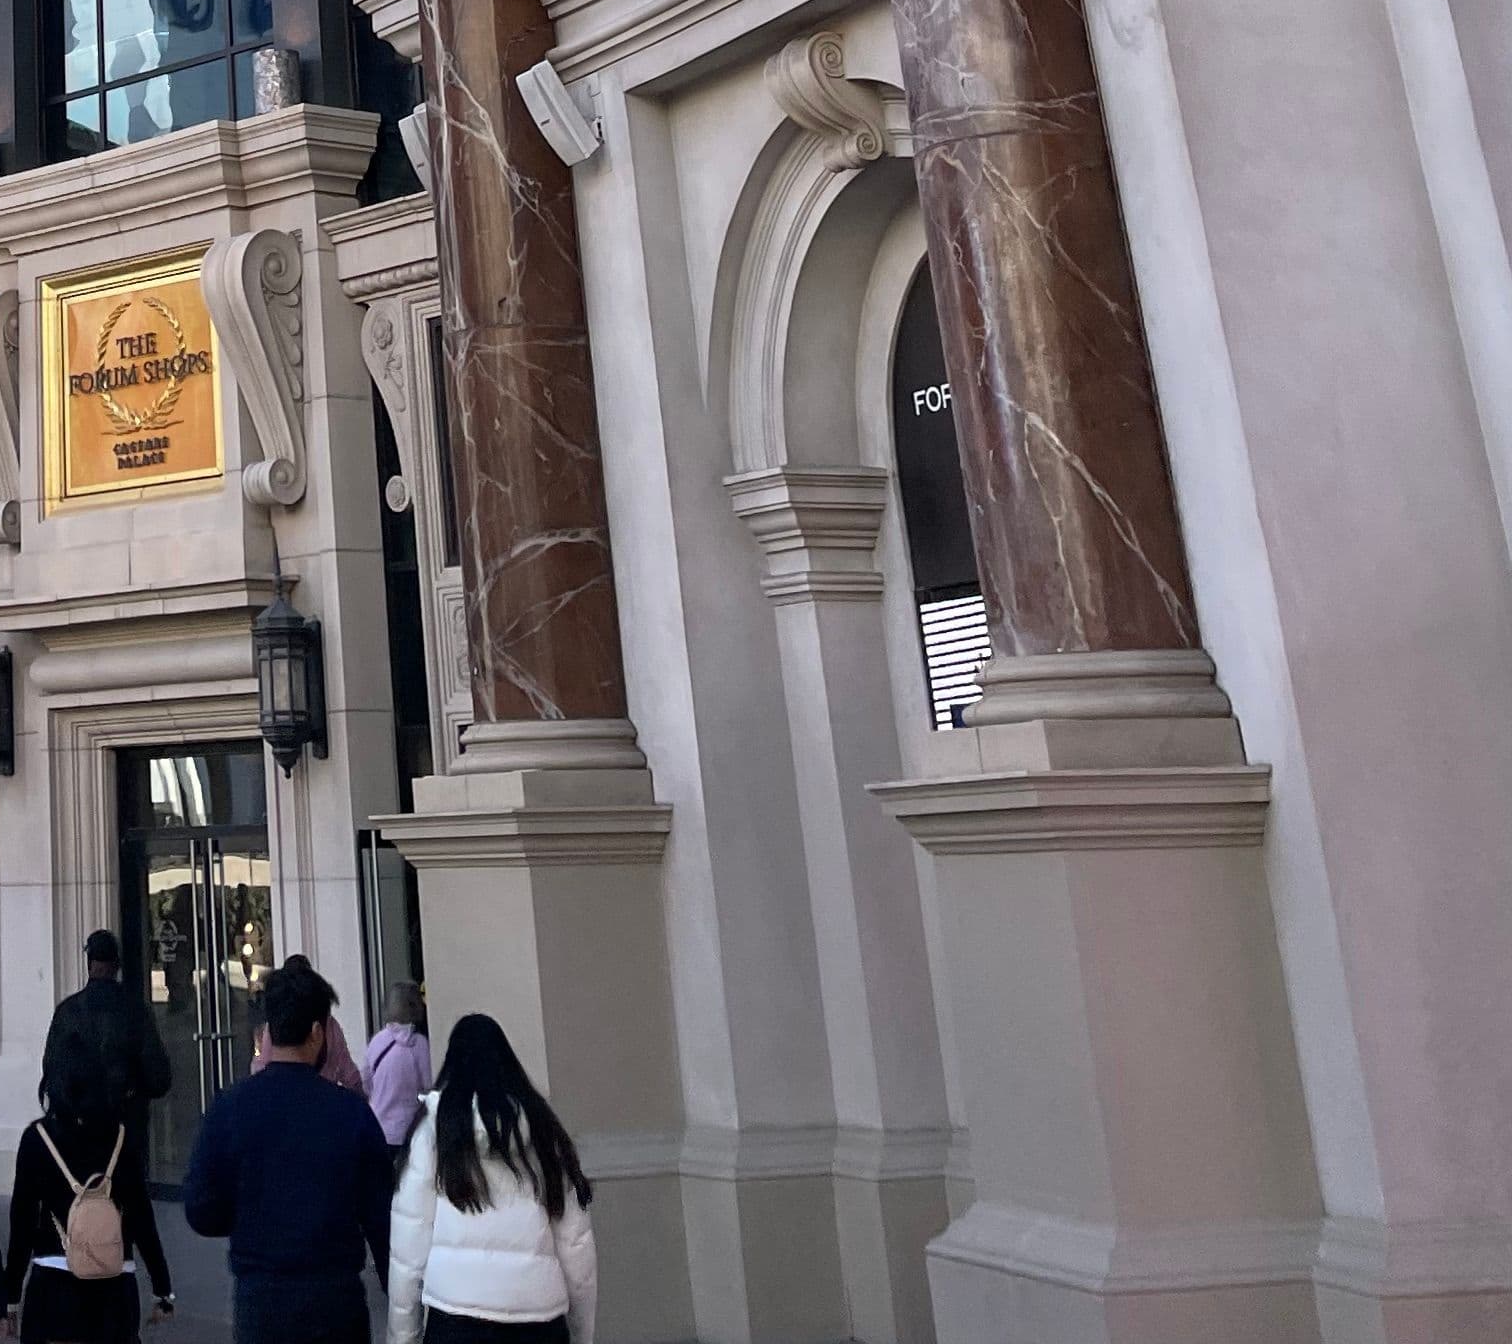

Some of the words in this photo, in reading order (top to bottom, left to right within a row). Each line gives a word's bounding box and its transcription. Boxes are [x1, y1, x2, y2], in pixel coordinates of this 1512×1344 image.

[116, 332, 157, 359] THE
[69, 364, 138, 395] FORUM
[143, 350, 210, 382] SHOPS
[113, 437, 169, 455] CAESARS
[118, 451, 166, 470] PALACE
